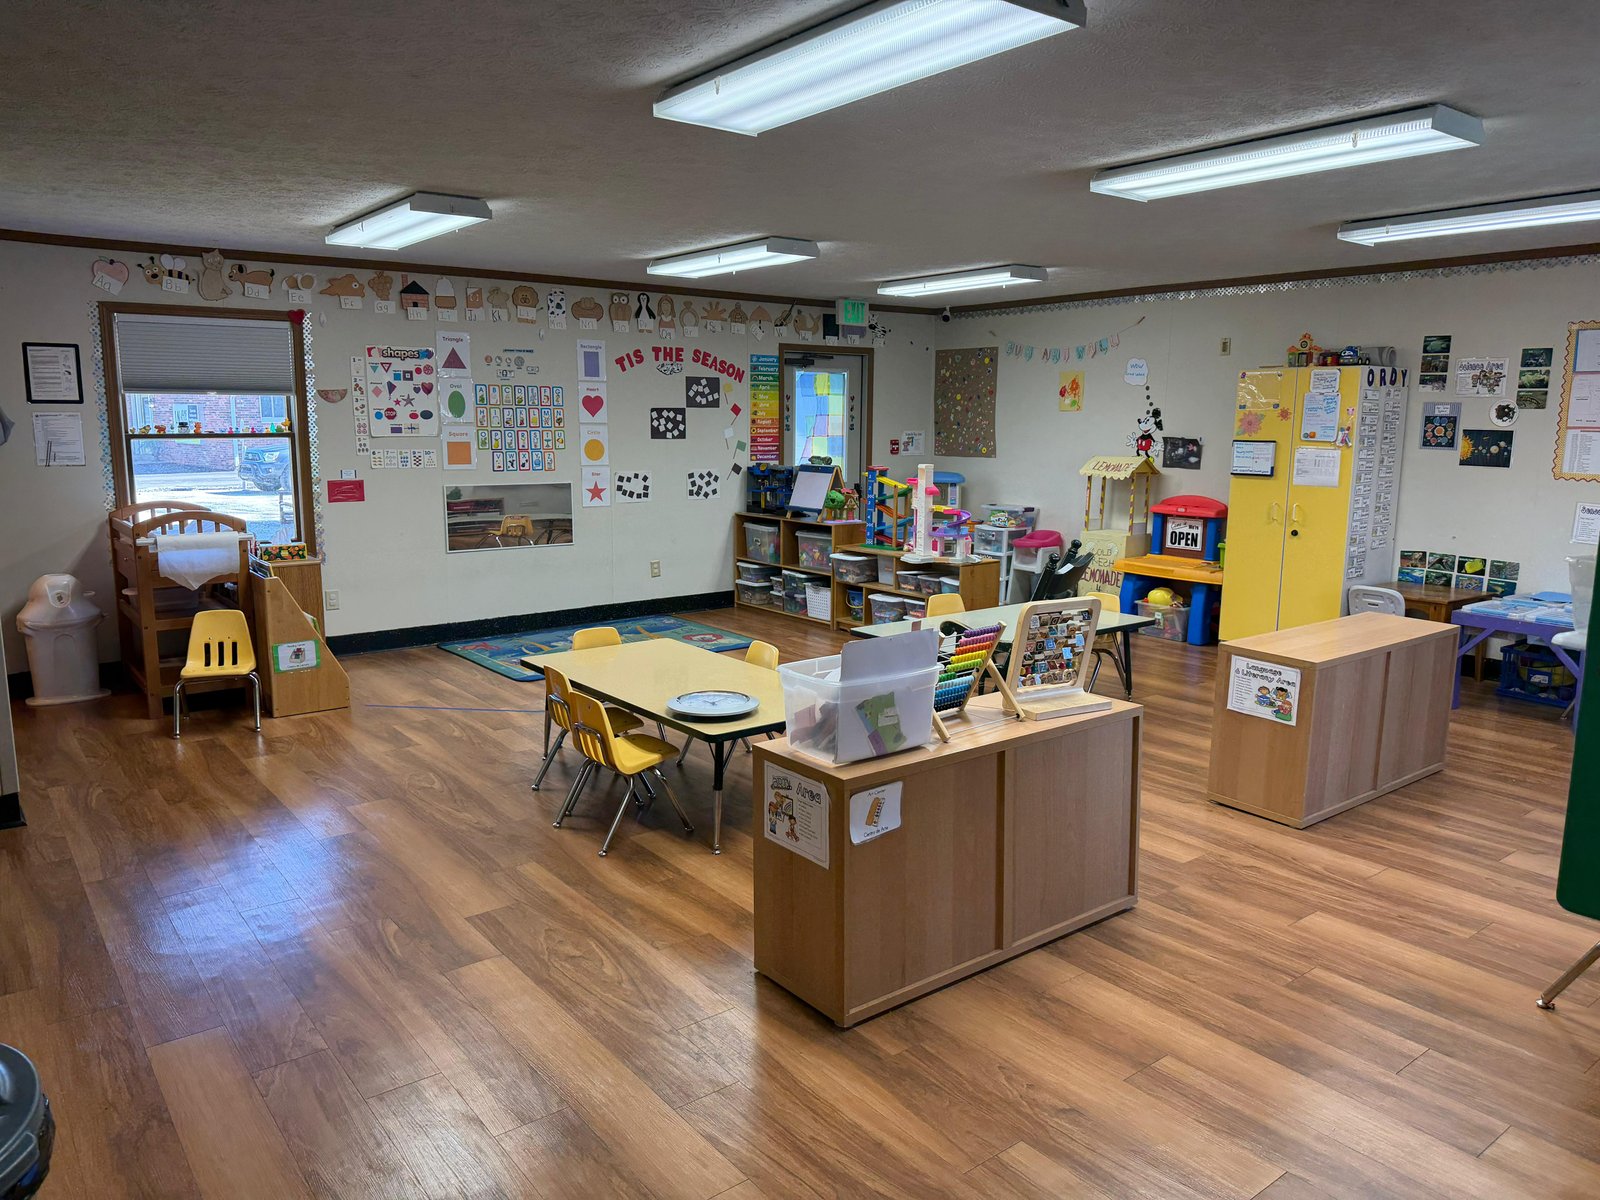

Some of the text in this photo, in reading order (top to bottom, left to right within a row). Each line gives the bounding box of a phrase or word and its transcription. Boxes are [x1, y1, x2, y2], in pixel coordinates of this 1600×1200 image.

[844, 300, 864, 324] EXIT
[382, 347, 420, 361] shapes
[614, 346, 746, 384] TIS THE SEASON
[1092, 461, 1132, 472] LEMONADE
[1170, 531, 1198, 547] OPEN
[1242, 669, 1274, 683] Literacy
[1276, 677, 1296, 687] Area
[1246, 663, 1282, 676] Language
[796, 783, 821, 804] Area
